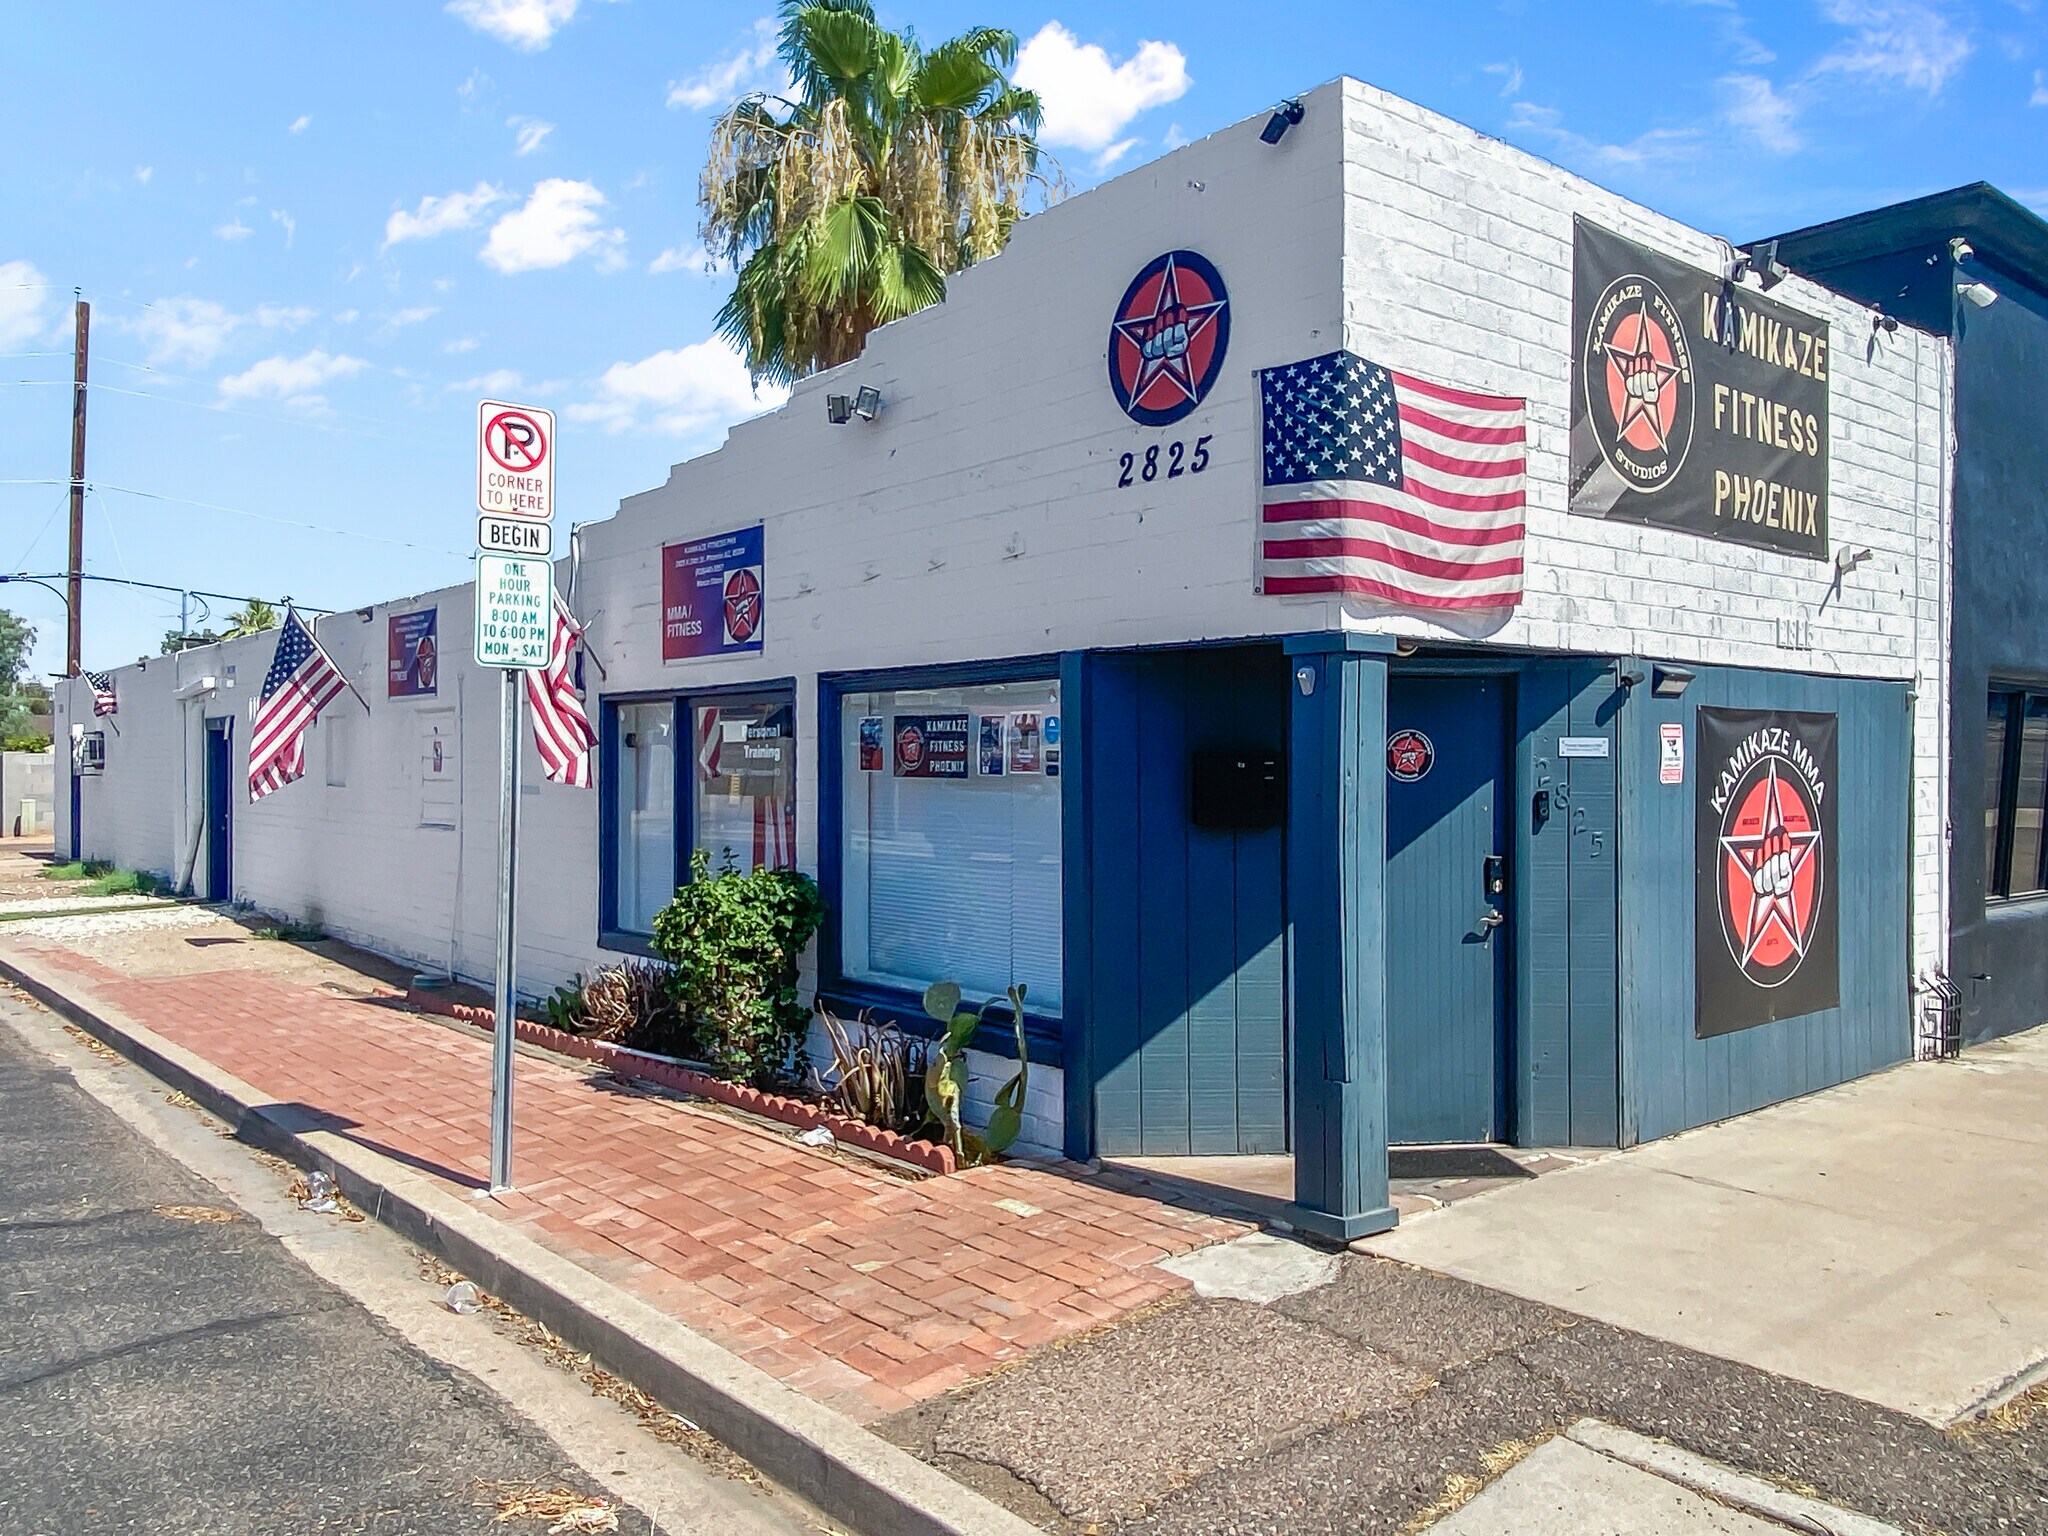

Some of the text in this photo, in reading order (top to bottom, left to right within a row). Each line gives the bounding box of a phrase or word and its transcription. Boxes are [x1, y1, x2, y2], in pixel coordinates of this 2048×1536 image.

[1593, 285, 1642, 355] KAMIKAZE
[1703, 291, 1828, 382] KAMIKAZE
[1713, 383, 1819, 457] FITNESS
[1117, 434, 1213, 489] 2825
[1615, 448, 1669, 480] STUDIOS
[488, 472, 543, 493] CORNER
[486, 489, 545, 511] TO HERE
[1714, 469, 1819, 537] PHOENIX
[490, 523, 540, 549] BEGIN
[504, 562, 527, 577] ONE
[499, 577, 531, 592] HOUR
[489, 592, 541, 608] PARKING
[492, 608, 538, 625] 8:00 AM
[483, 623, 545, 641] TO 6:00 PM
[666, 619, 703, 639] FITNESS
[484, 641, 509, 655] MON
[522, 643, 544, 657] SAT
[926, 720, 968, 732] KAMIKAZE
[743, 743, 781, 762] Training
[929, 740, 965, 752] FITNESS
[929, 760, 965, 772] PHOENIX
[1710, 727, 1826, 815] KAMIKAZE MMA
